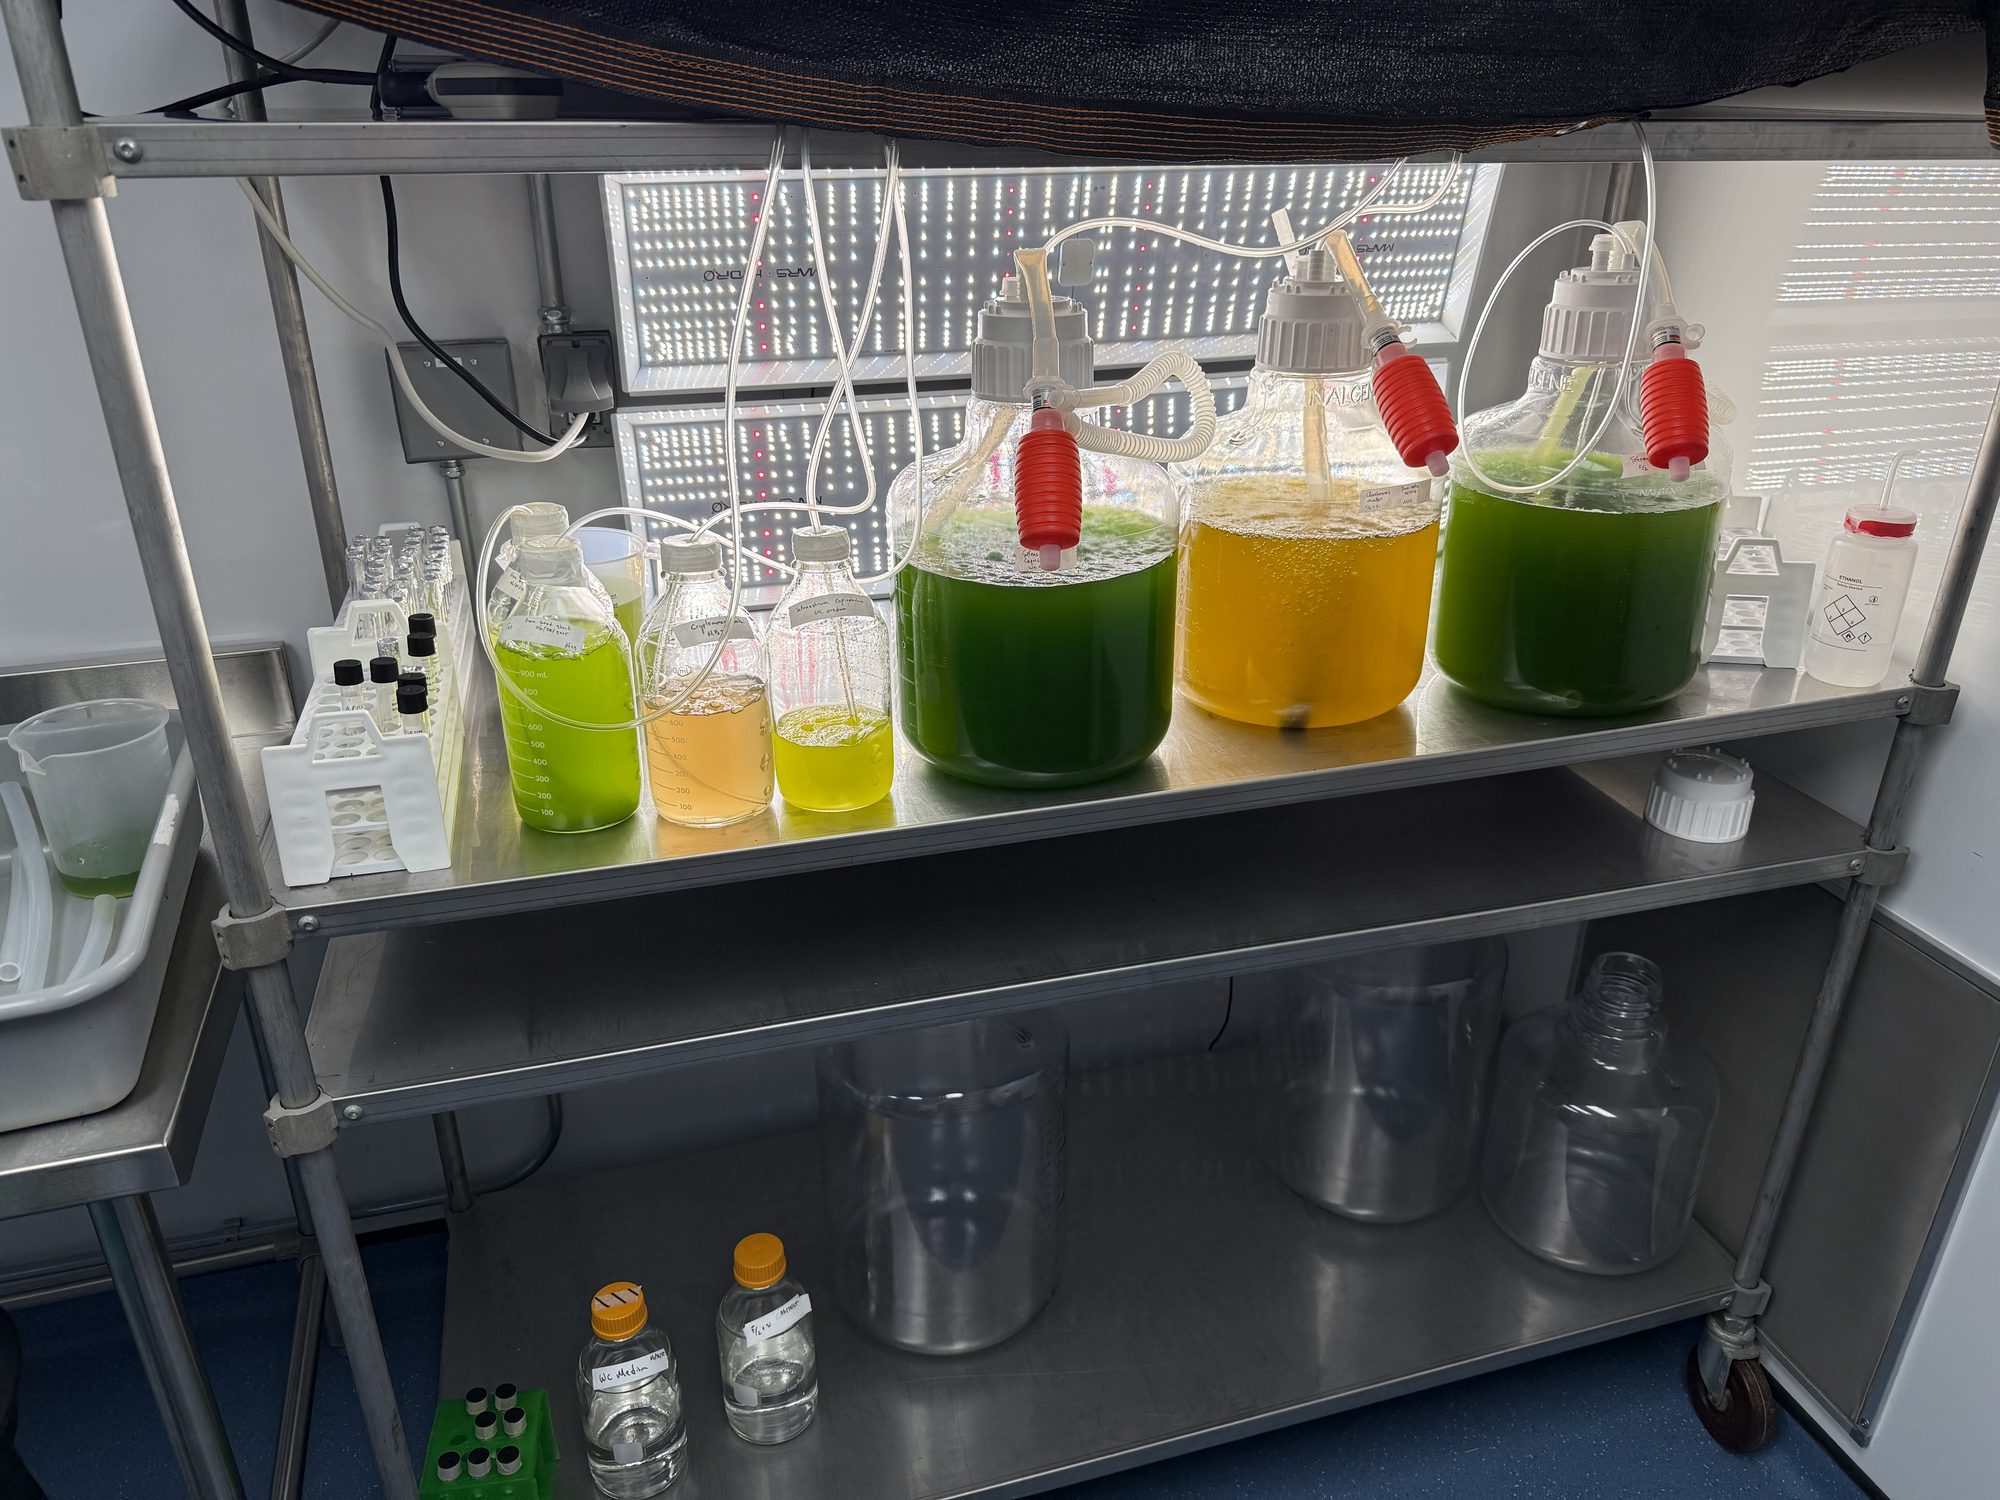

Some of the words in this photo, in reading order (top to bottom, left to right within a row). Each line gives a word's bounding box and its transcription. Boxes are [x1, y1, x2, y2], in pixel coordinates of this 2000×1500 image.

[1839, 574, 1863, 585] ETHANOL
[520, 670, 535, 678] 900
[528, 723, 543, 731] 600
[671, 736, 686, 744] 500
[531, 740, 545, 749] 500
[673, 753, 688, 761] 400
[533, 758, 548, 766] 400
[535, 775, 550, 783] 300
[676, 786, 691, 794] 200
[537, 791, 552, 800] 200
[680, 803, 692, 811] 100
[541, 808, 554, 817] 100
[598, 1372, 614, 1384] WC
